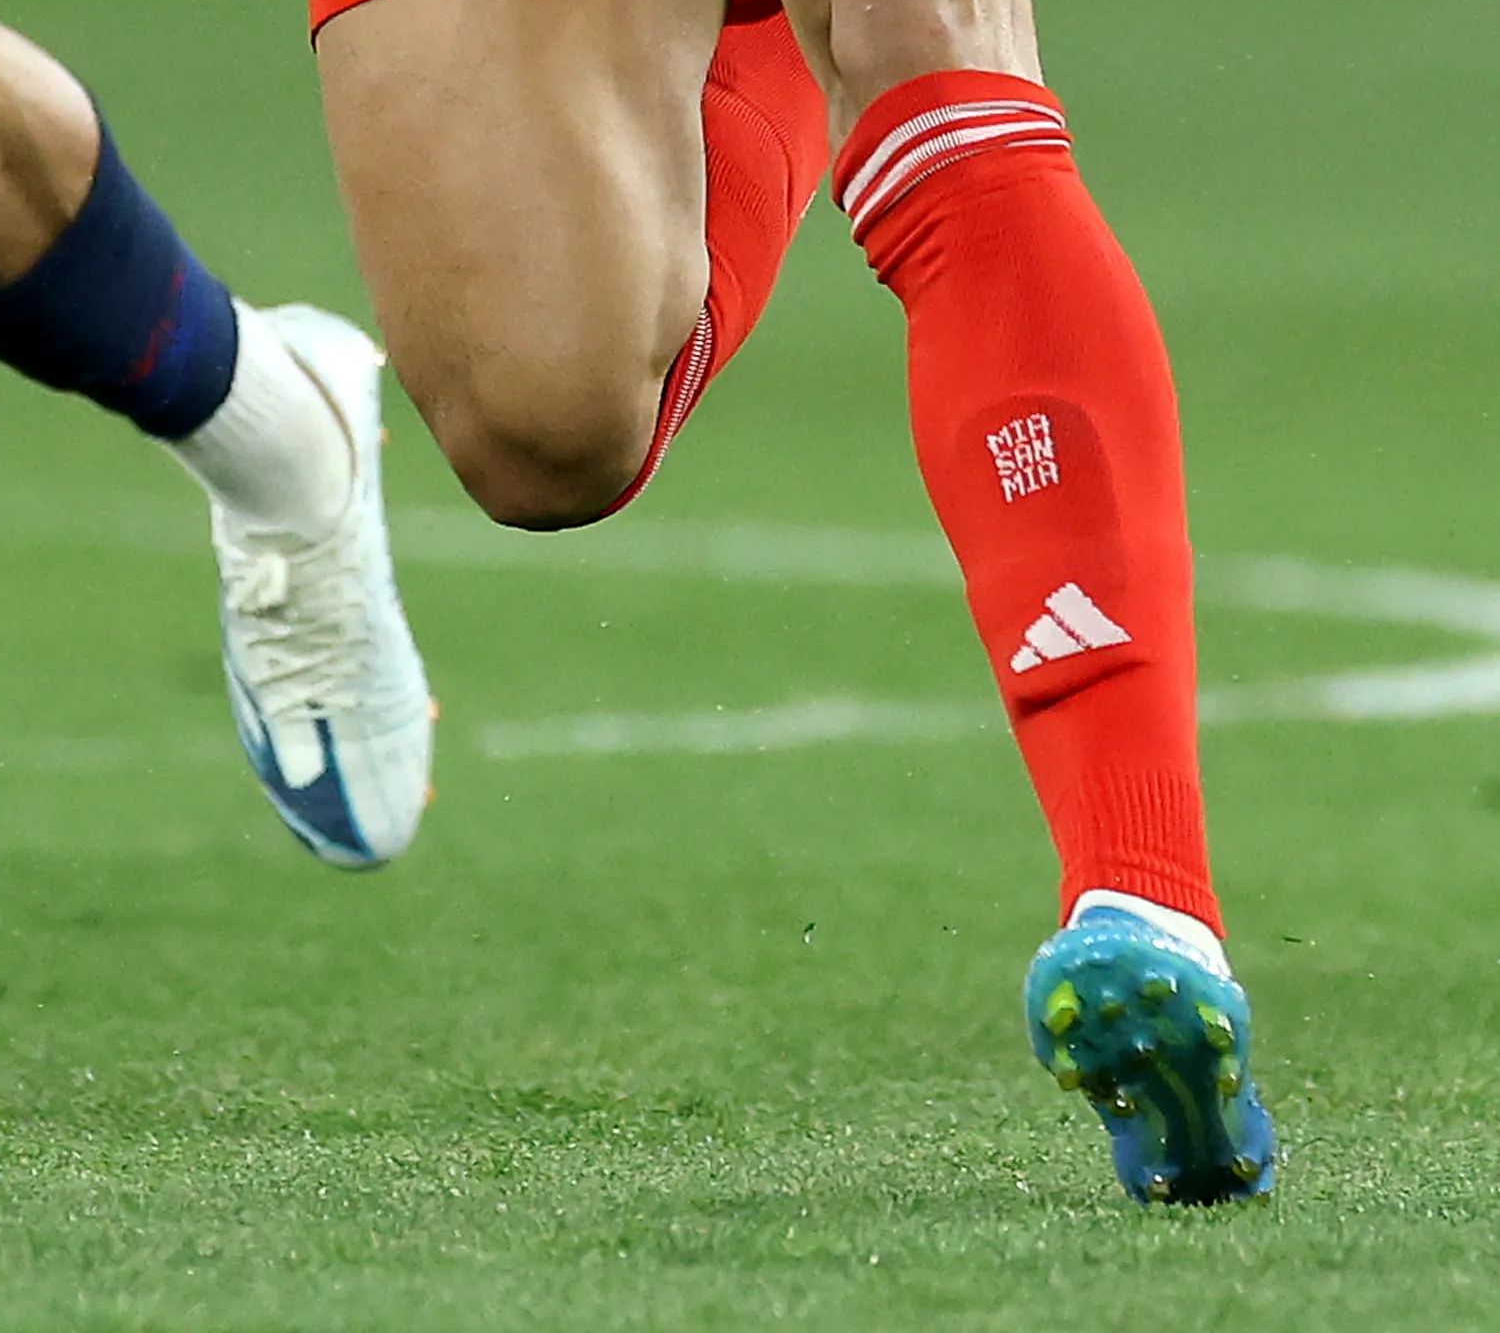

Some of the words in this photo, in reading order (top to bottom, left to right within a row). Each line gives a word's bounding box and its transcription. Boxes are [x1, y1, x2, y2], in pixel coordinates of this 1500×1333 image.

[986, 413, 1050, 457] MIA
[995, 436, 1054, 477] SAN
[1001, 460, 1060, 504] MIA
